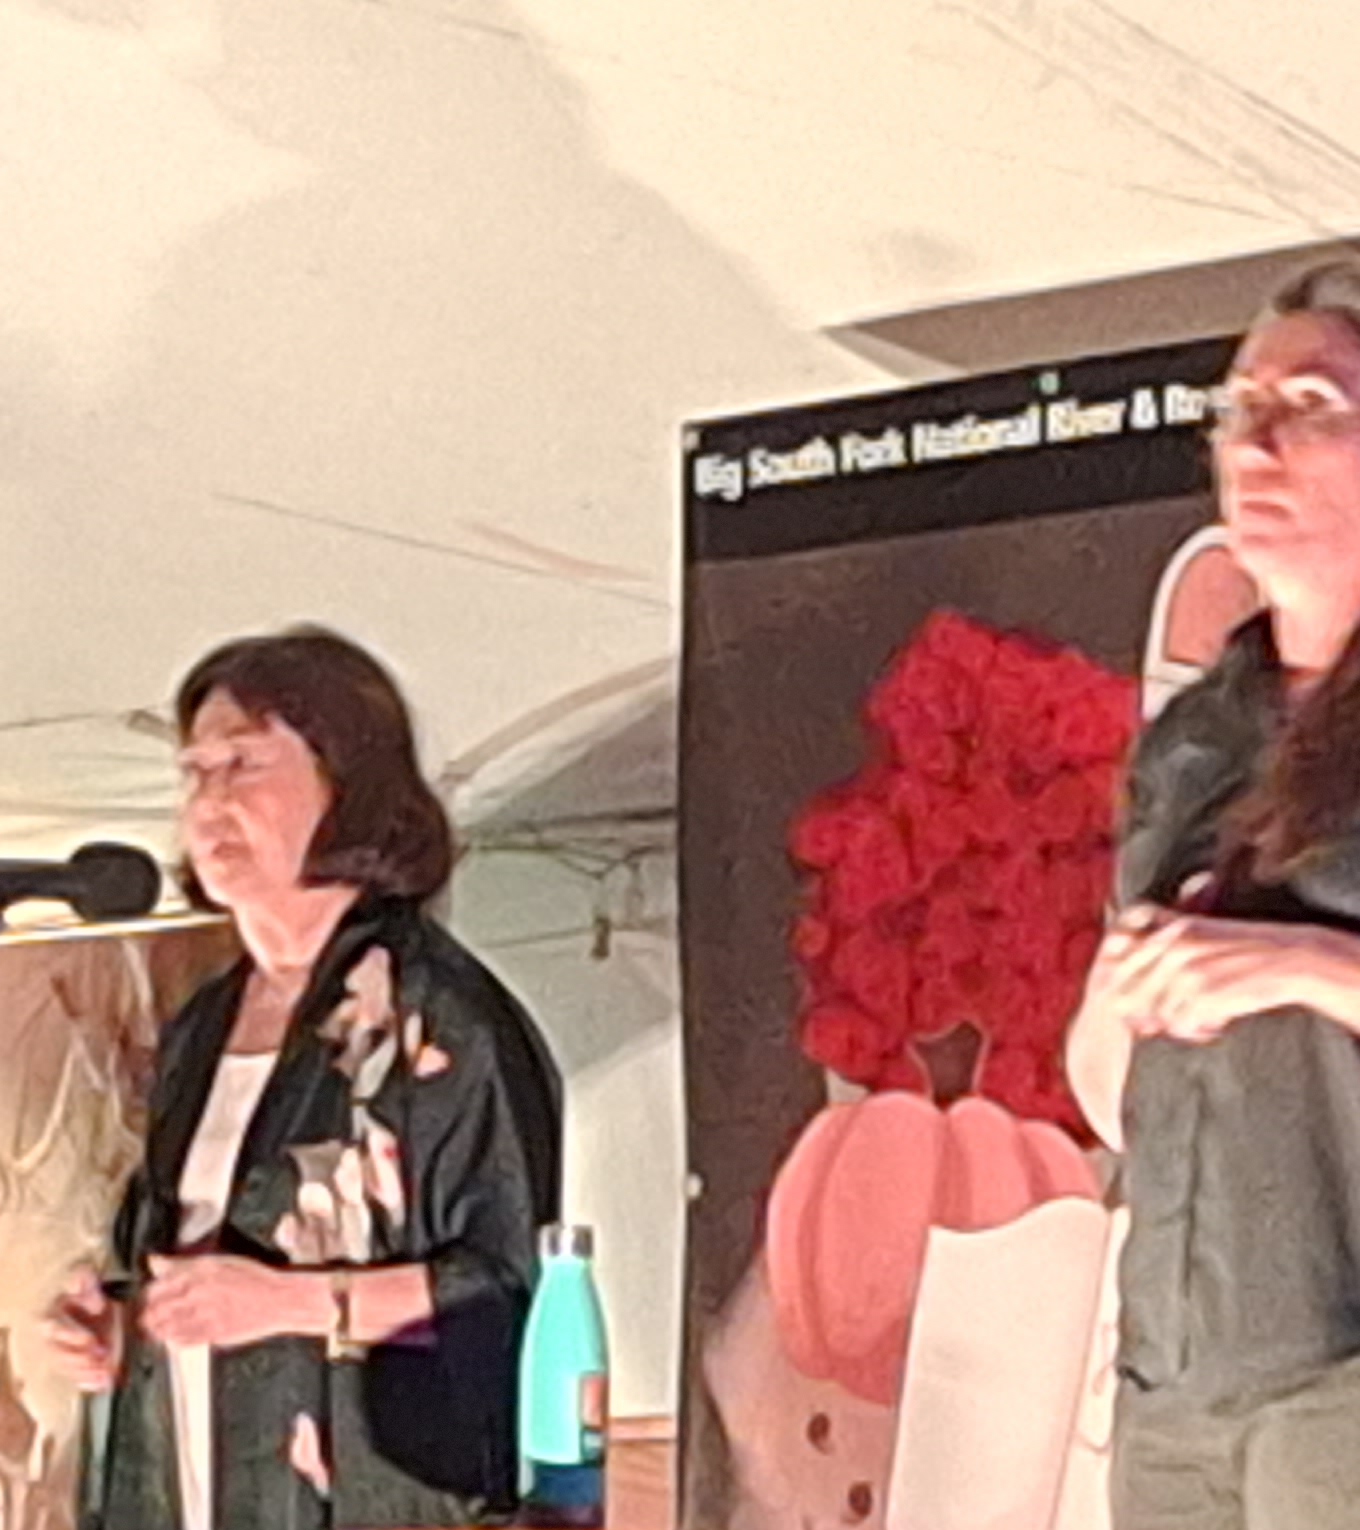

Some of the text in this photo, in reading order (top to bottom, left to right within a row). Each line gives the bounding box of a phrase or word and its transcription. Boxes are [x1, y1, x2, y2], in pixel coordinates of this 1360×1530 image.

[695, 454, 742, 501] Big
[747, 447, 837, 489] South
[840, 430, 909, 474] Fork
[911, 402, 1041, 463] National
[1046, 399, 1127, 443] River
[1129, 387, 1159, 430] &
